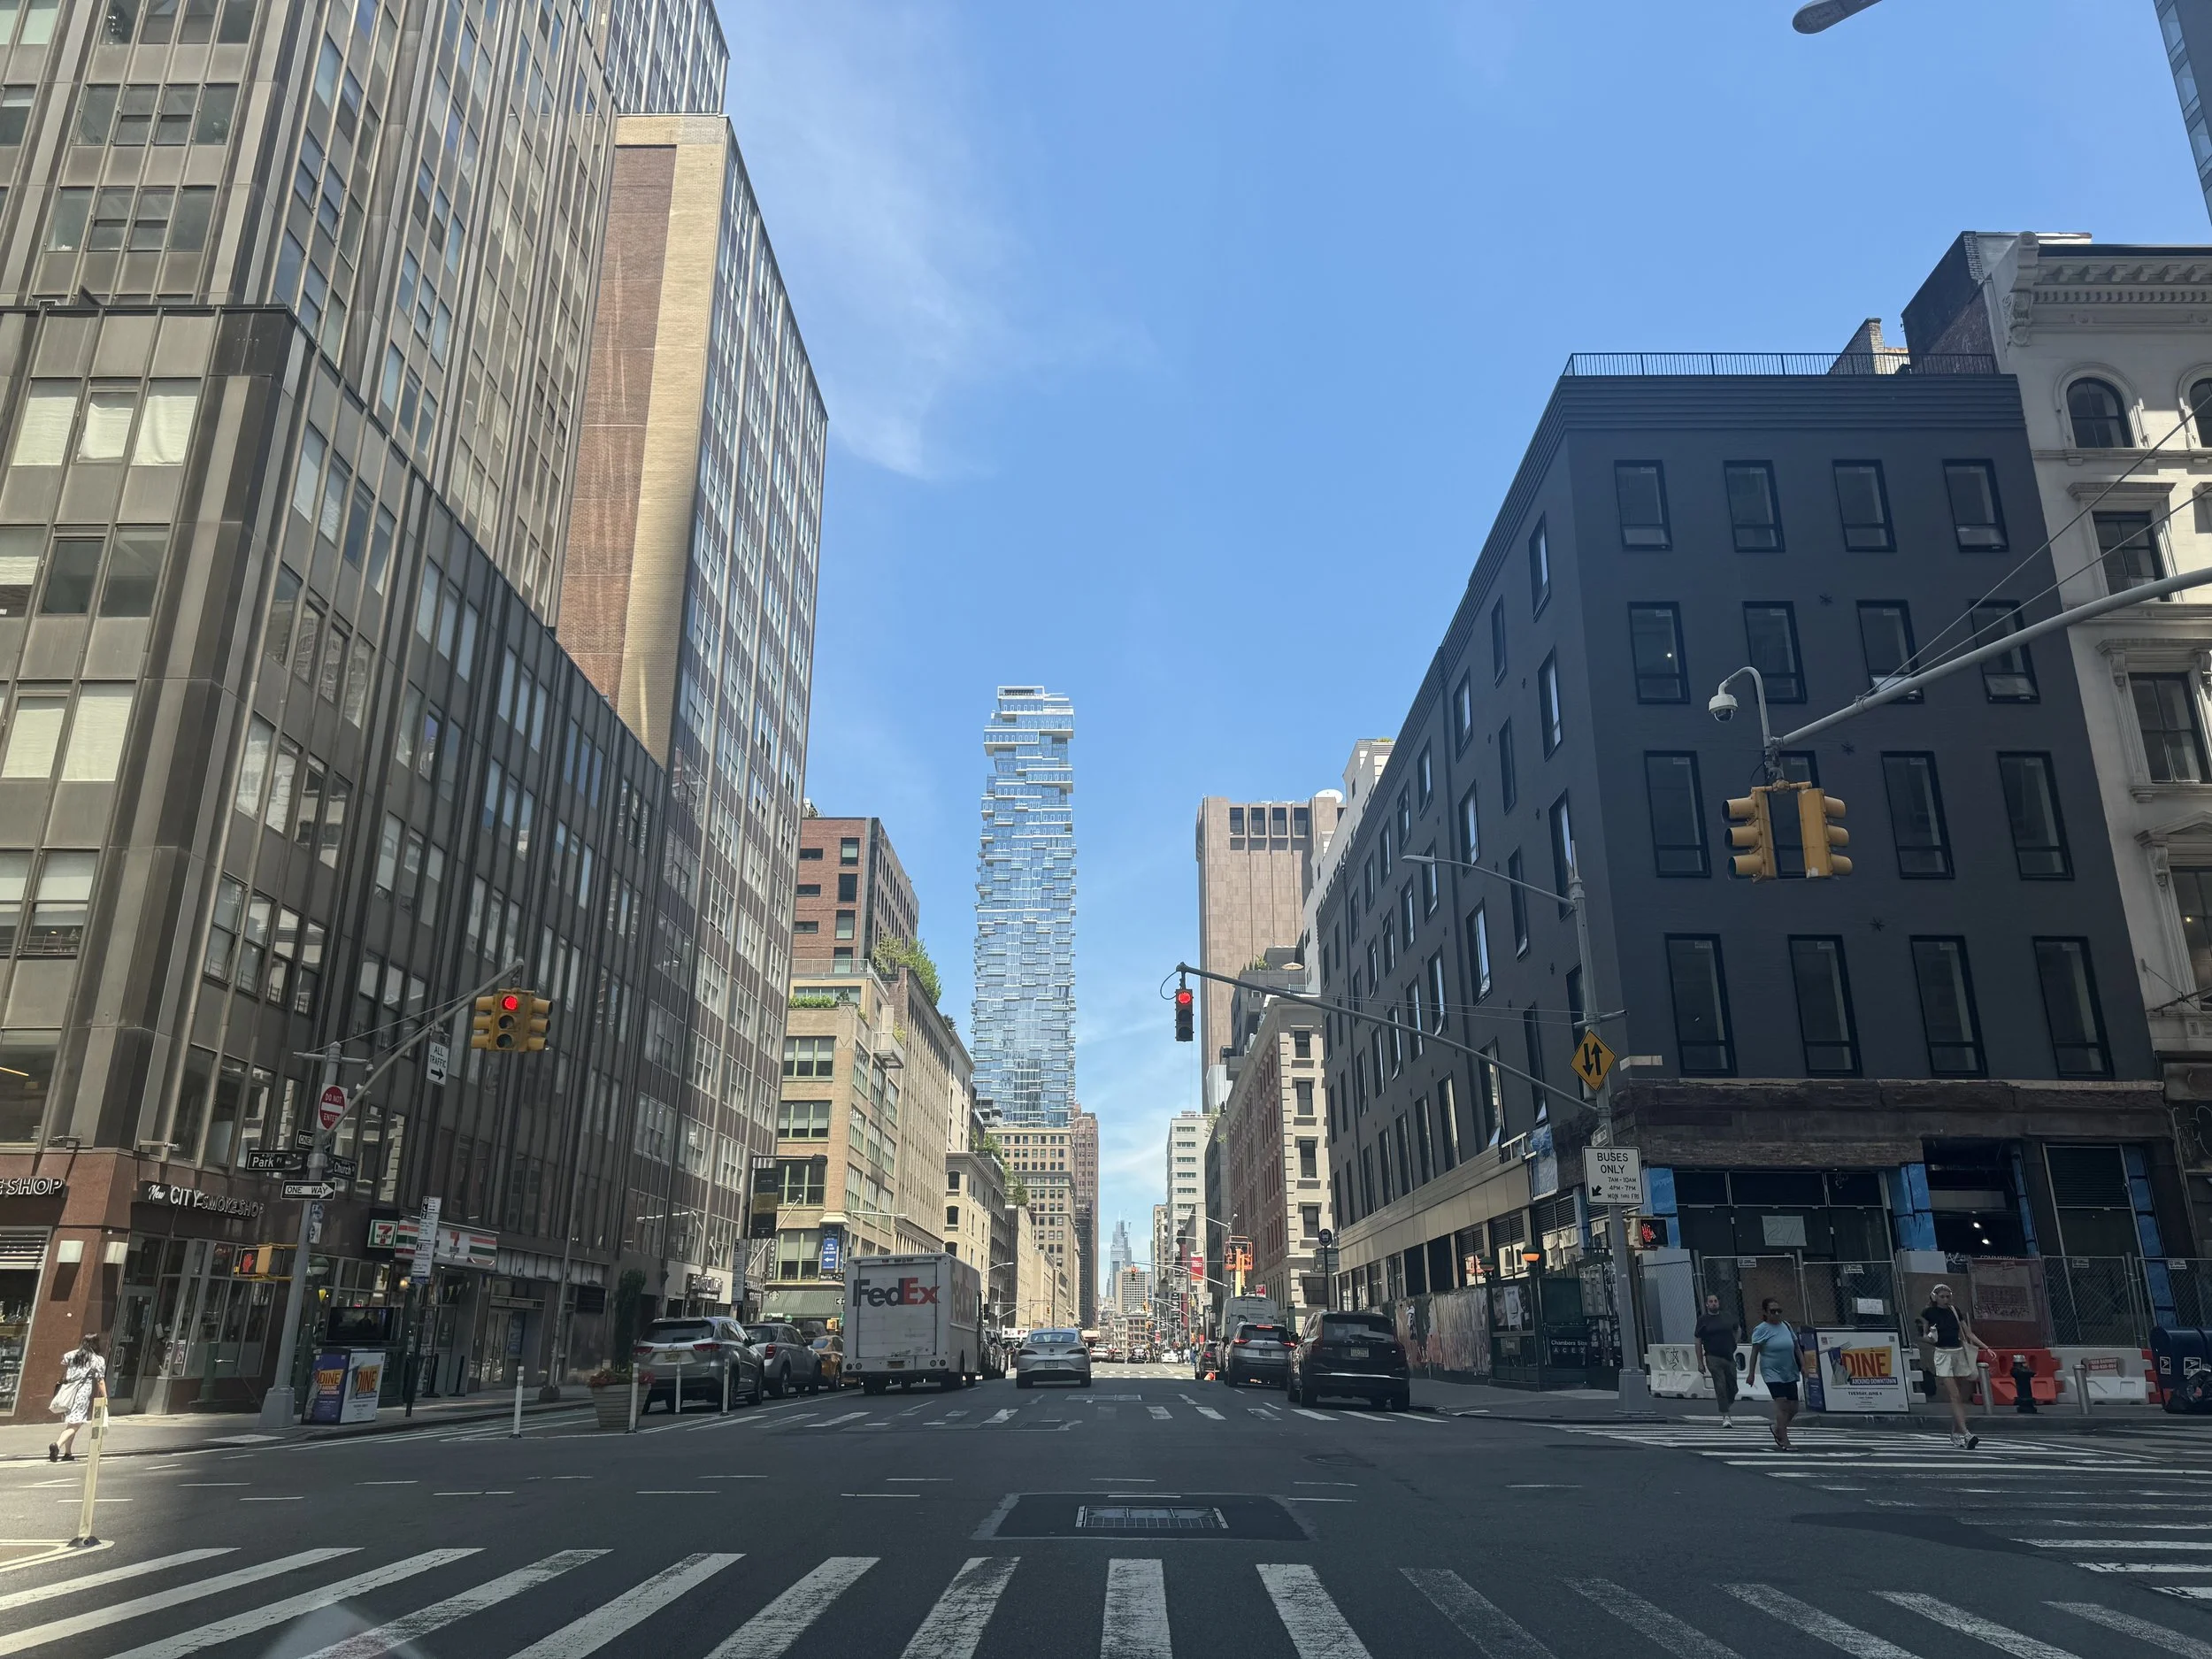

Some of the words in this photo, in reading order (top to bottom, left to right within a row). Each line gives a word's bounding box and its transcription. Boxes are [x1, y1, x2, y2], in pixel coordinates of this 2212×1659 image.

[434, 1046, 443, 1056] ALL
[430, 1055, 446, 1068] TRAFFIC
[325, 1093, 332, 1102] DO
[252, 1156, 273, 1168] Park
[1597, 1152, 1628, 1162] BUSES
[1600, 1164, 1624, 1174] ONLY
[6, 1178, 63, 1195] SHOP
[149, 1184, 165, 1201] New
[170, 1186, 200, 1208] CITY
[378, 1225, 392, 1246] 7
[853, 1278, 941, 1307] FedEx
[1841, 1352, 1889, 1378] DINE
[319, 1372, 341, 1384] DINE
